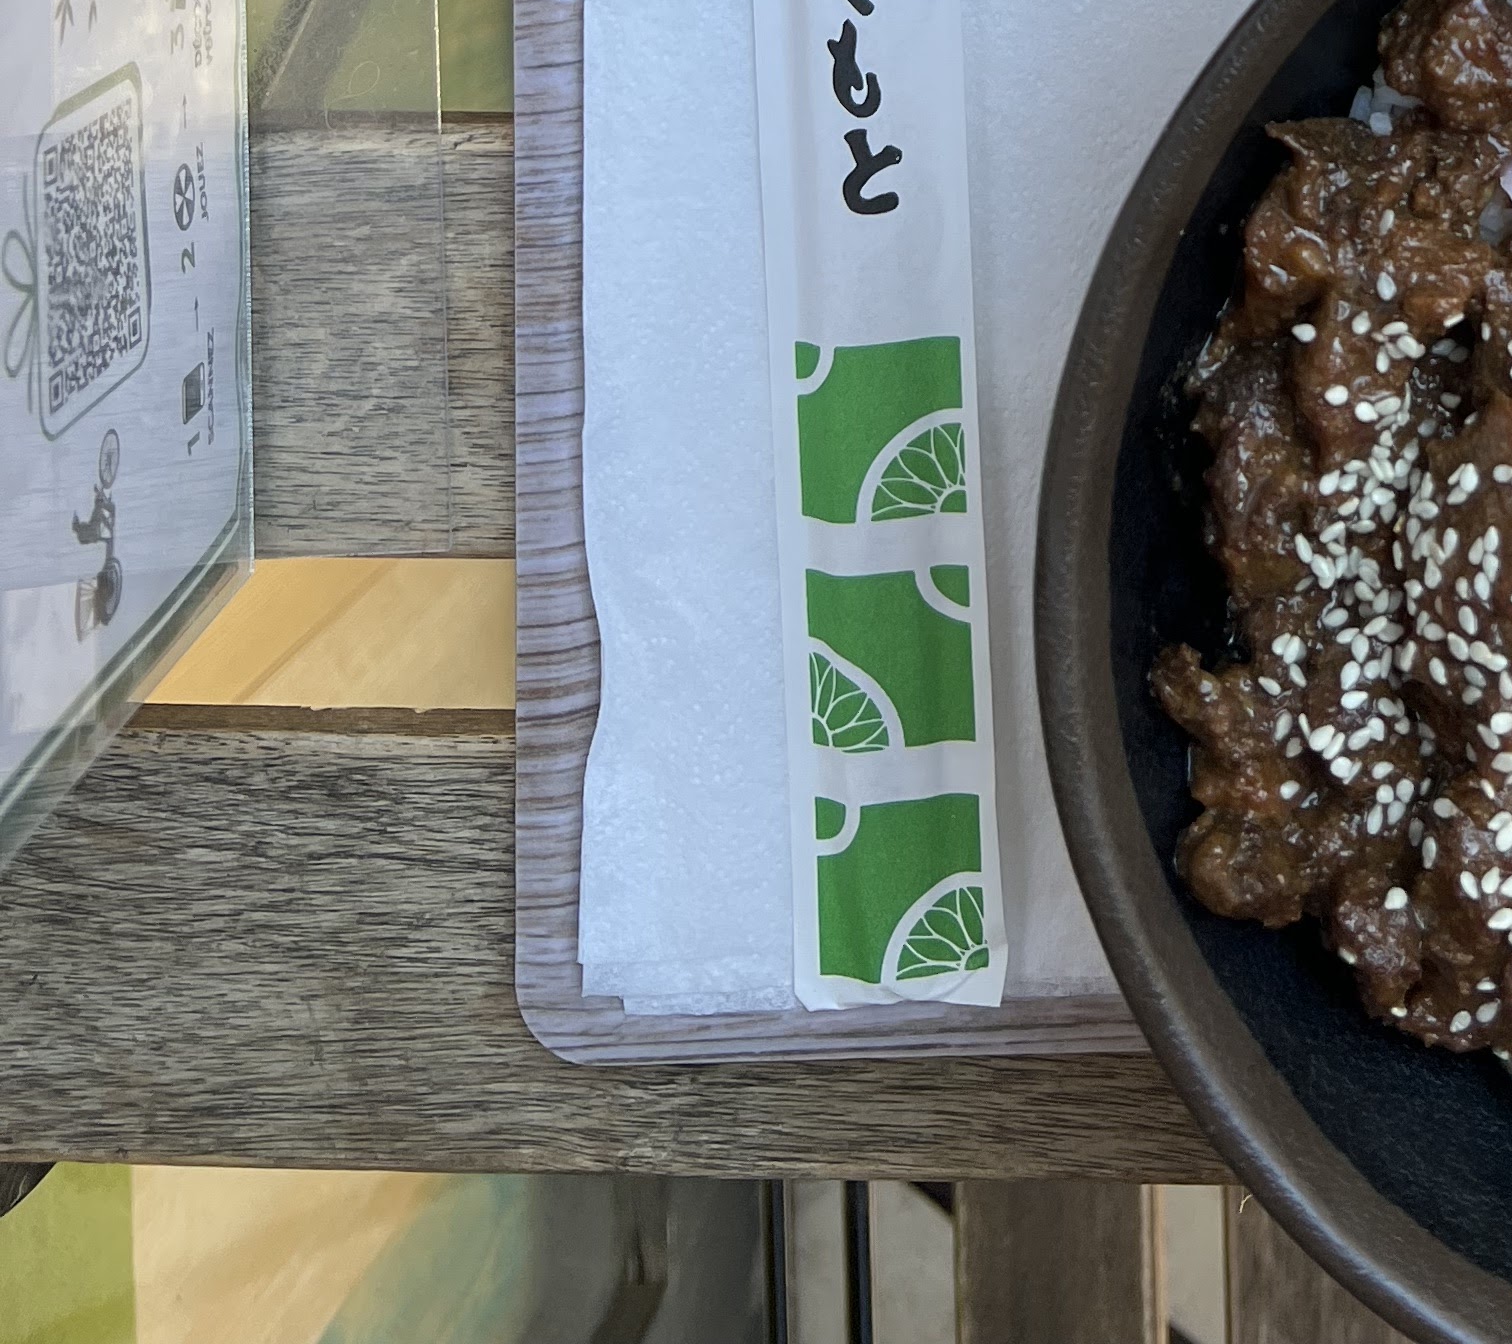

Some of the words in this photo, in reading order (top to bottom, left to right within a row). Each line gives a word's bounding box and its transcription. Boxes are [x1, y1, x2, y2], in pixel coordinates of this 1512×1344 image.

[170, 23, 185, 55] 3
[196, 141, 209, 222] JOUEZ
[181, 242, 195, 275] 2
[187, 431, 201, 457] 1
